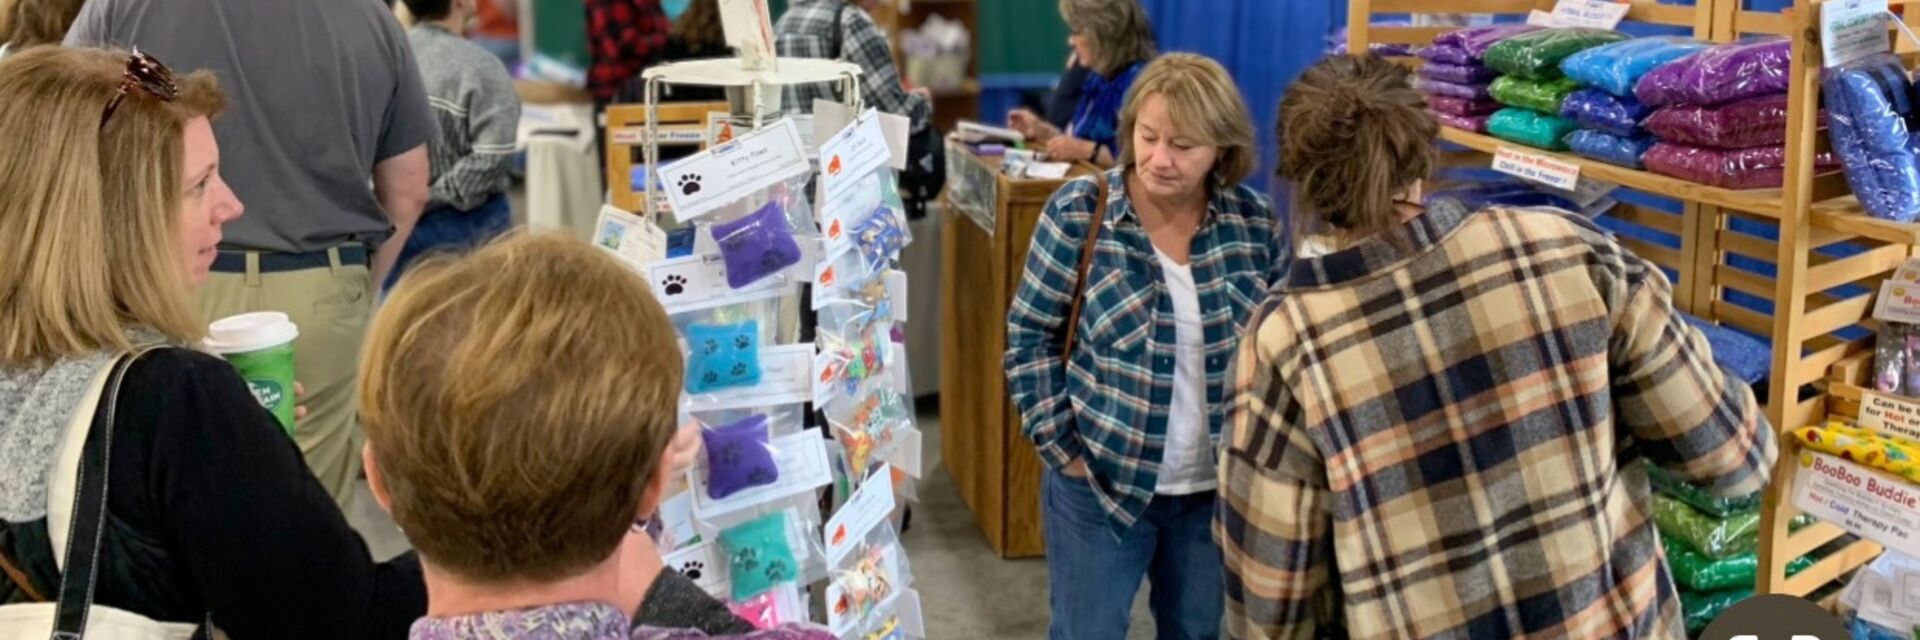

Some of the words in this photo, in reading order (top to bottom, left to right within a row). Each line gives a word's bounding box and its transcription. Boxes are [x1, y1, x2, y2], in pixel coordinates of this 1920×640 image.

[1866, 405, 1881, 416] for
[1884, 410, 1905, 424] Hot
[1873, 397, 1894, 409] Can
[1898, 403, 1912, 414] be
[1813, 456, 1861, 487] BooBoo
[1808, 491, 1824, 503] Hot
[1829, 500, 1850, 514] Cold
[1853, 510, 1889, 532] Therapy
